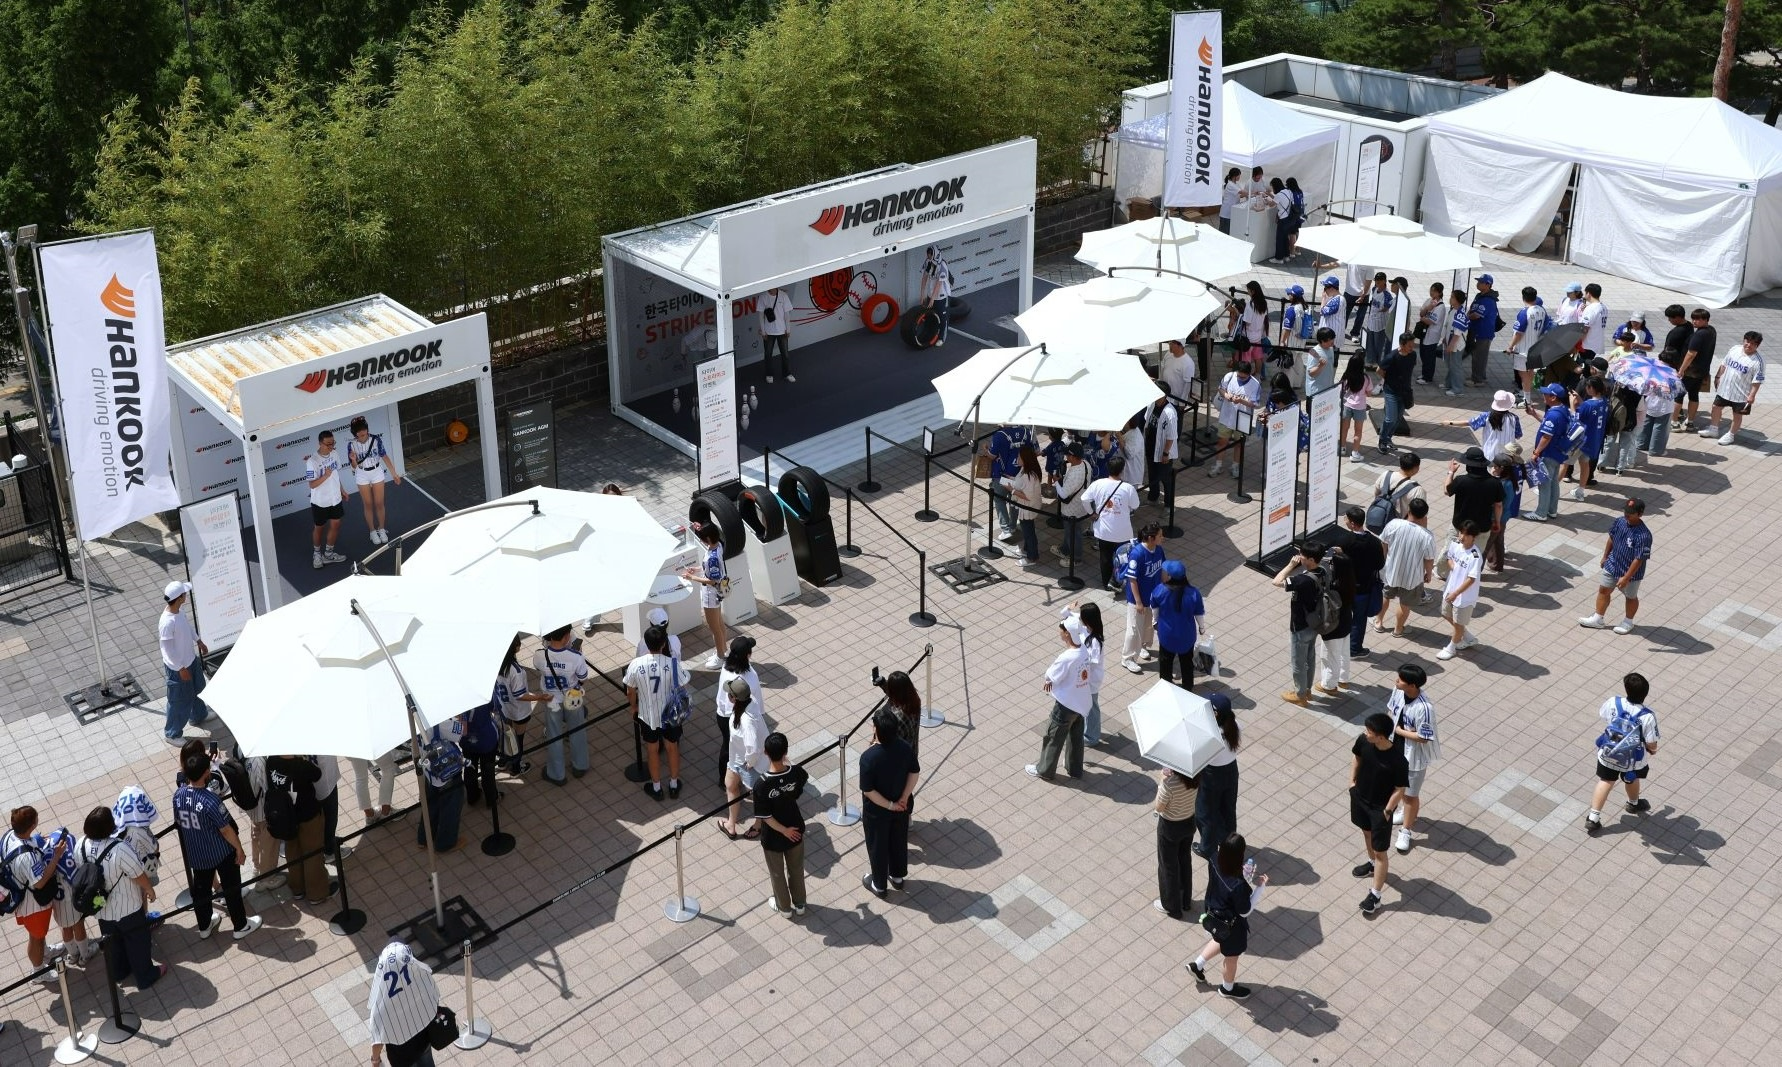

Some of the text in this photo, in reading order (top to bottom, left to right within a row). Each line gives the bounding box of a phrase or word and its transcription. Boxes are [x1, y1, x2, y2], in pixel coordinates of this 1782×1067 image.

[1184, 96, 1197, 184] driving emotion
[872, 202, 964, 237] driving emotion
[644, 292, 704, 320] 한국타이어
[645, 297, 757, 344] STRIKE ON
[356, 359, 442, 390] driving emotion
[1727, 359, 1749, 374] LIONS
[91, 367, 118, 497] driving emotion
[1145, 559, 1163, 577] Lion
[546, 661, 566, 670] LONS
[639, 662, 670, 675] 김상수
[649, 676, 661, 694] 7
[178, 809, 201, 830] 58
[383, 964, 412, 999] 21
